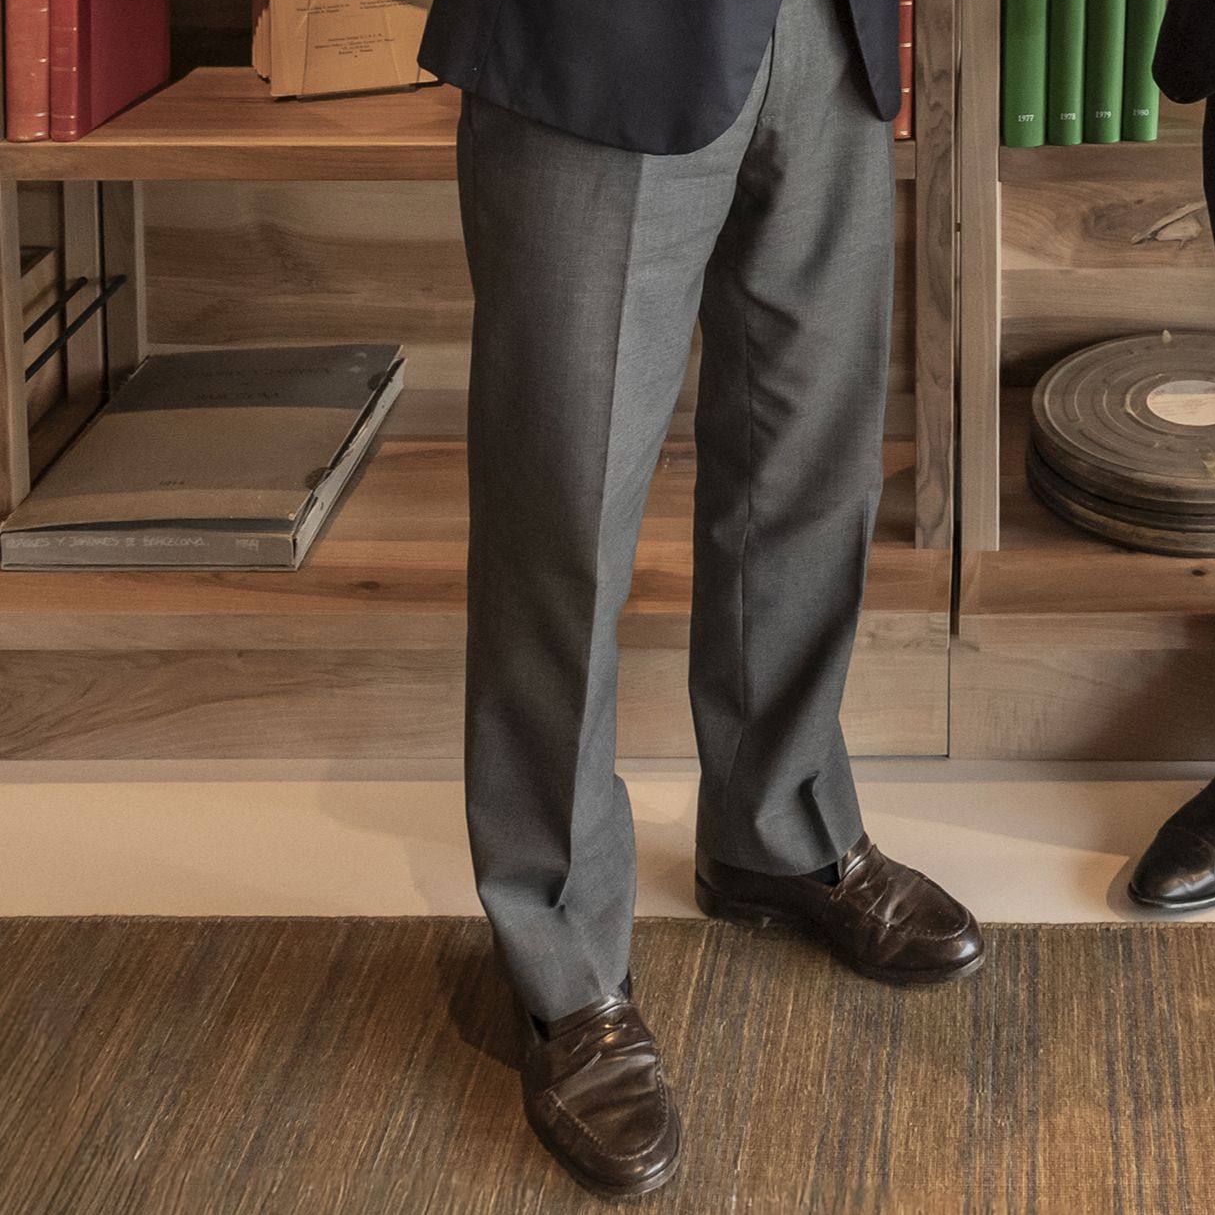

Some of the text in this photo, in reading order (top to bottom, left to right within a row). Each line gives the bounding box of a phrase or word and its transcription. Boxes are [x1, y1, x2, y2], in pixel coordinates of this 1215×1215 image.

[1060, 112, 1077, 121] 1978
[1095, 111, 1112, 119] 1979
[1132, 109, 1150, 117] 1980
[1017, 114, 1034, 122] 1977
